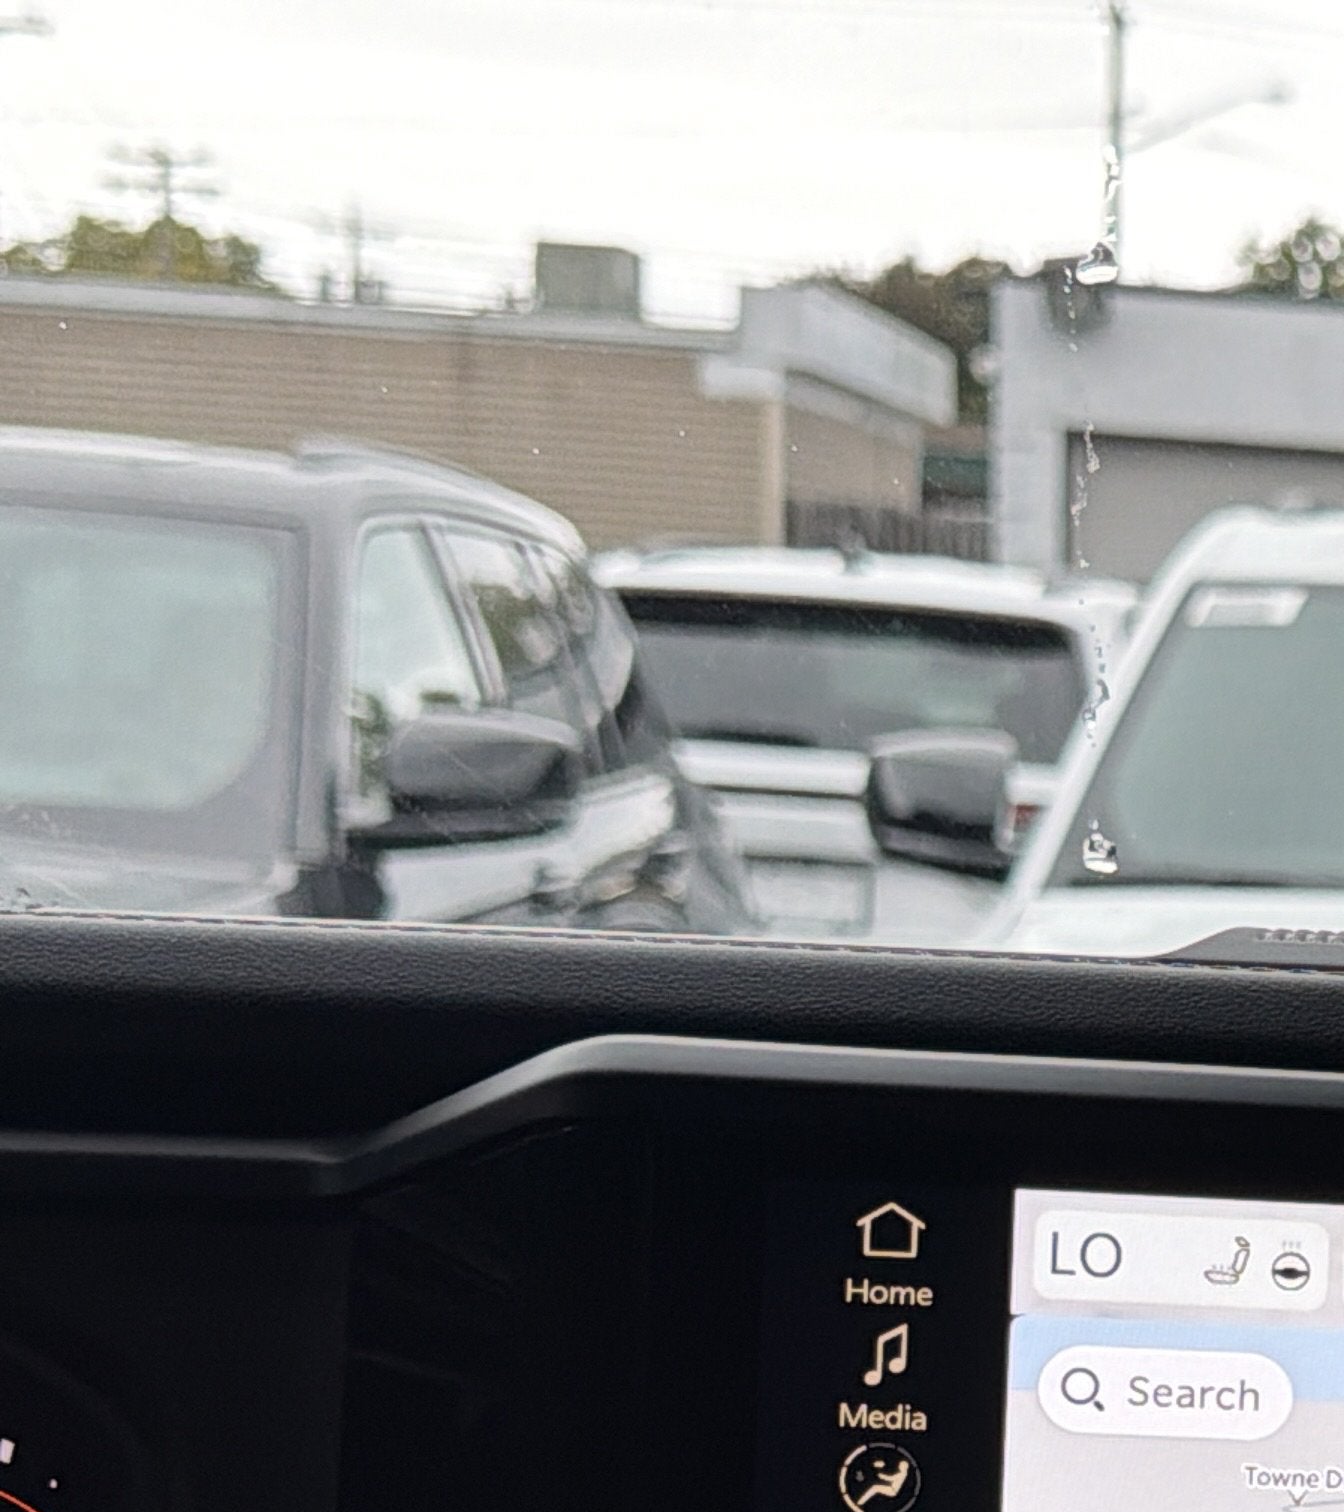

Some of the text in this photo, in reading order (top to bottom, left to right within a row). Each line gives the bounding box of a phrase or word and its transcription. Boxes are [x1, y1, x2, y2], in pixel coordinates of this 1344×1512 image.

[1050, 1231, 1123, 1278] LO
[845, 1279, 934, 1307] Home
[1128, 1375, 1261, 1412] Search
[838, 1403, 928, 1432] Media
[1245, 1466, 1320, 1489] Towne
